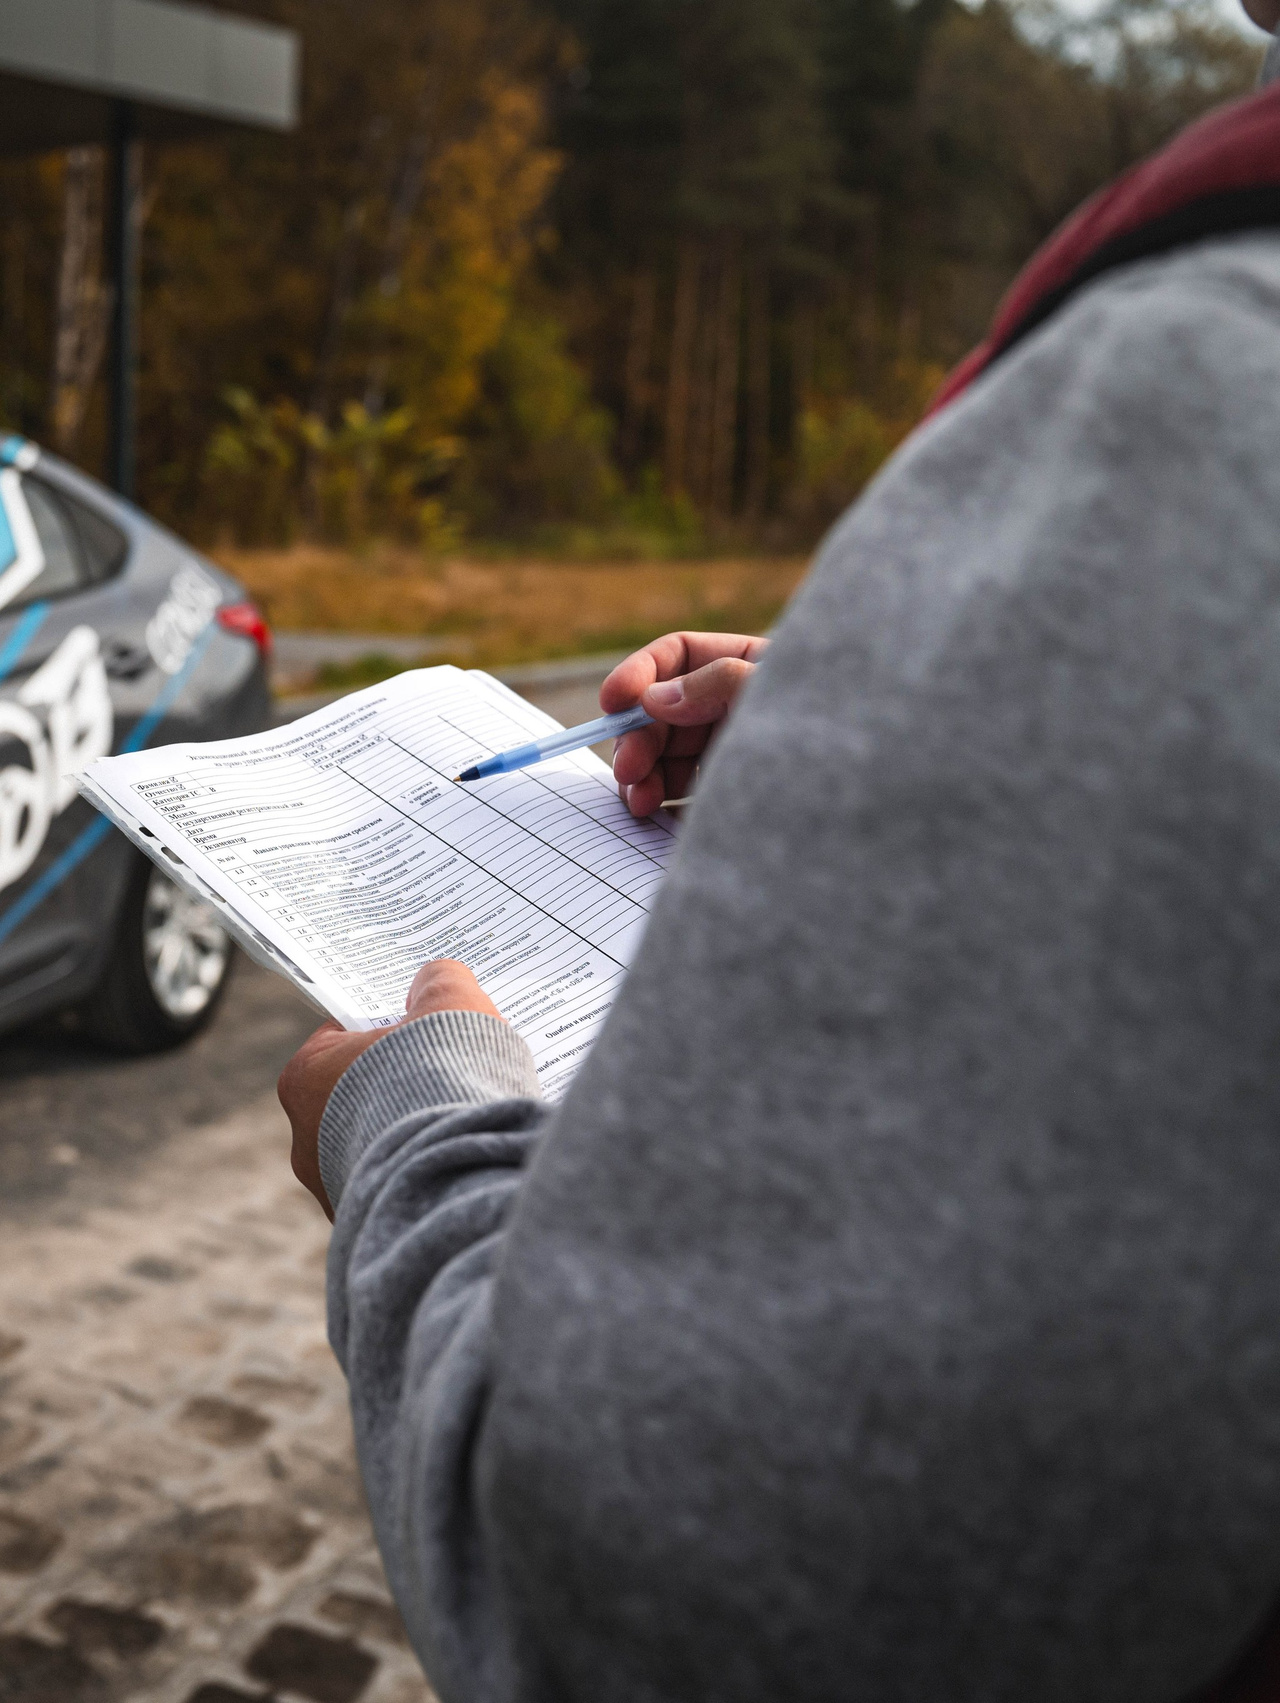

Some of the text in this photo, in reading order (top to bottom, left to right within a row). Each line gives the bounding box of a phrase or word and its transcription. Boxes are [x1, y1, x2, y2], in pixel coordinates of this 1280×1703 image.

[137, 778, 170, 791] Фамилия
[144, 786, 177, 799] Отчество
[152, 793, 190, 807] Категория
[160, 802, 187, 814] Марка
[168, 810, 198, 822] Модель
[176, 808, 236, 829] Государственный
[184, 827, 205, 837] Дата
[350, 817, 383, 835] средством
[193, 833, 218, 845] Время
[200, 836, 247, 851] Экзаменатор
[545, 1022, 573, 1039] Ошибки
